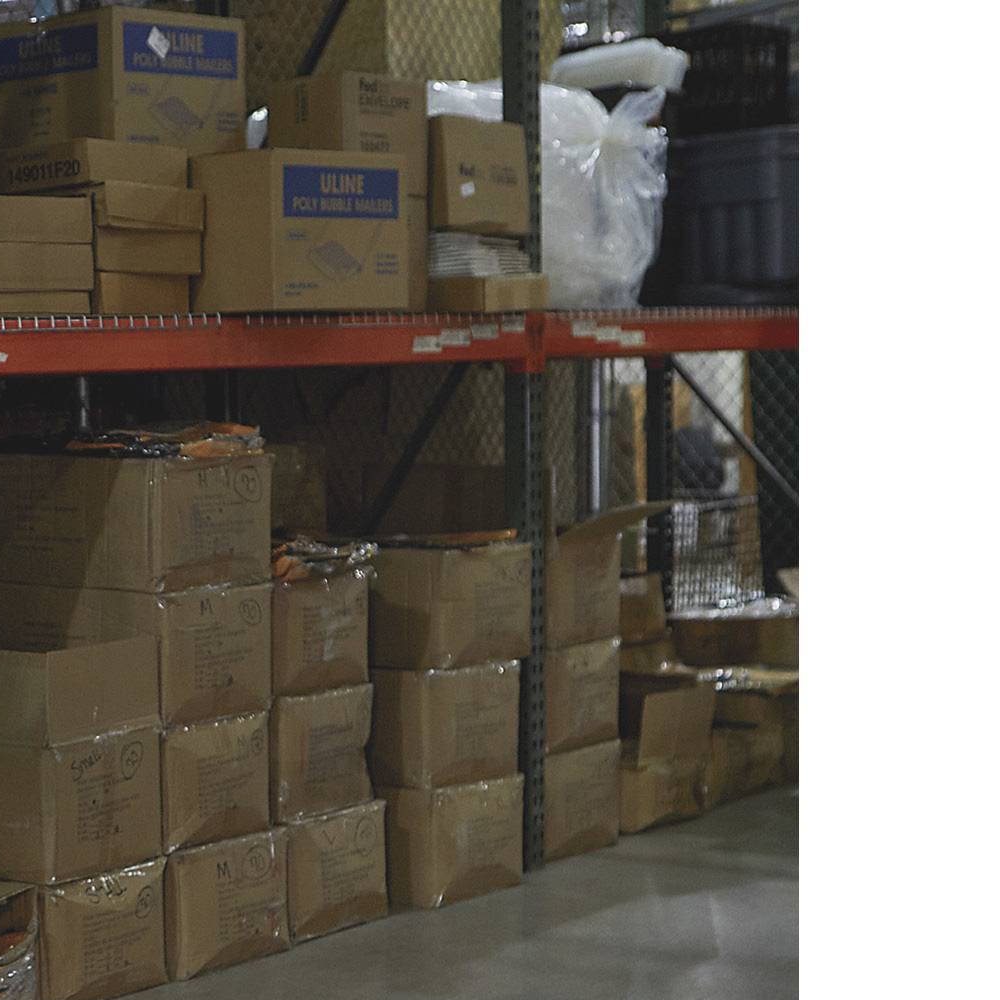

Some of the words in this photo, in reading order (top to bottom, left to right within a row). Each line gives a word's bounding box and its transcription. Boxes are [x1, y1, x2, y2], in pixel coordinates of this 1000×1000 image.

[320, 172, 365, 195] ULINE
[292, 196, 318, 210] POLY
[216, 860, 232, 879] M
